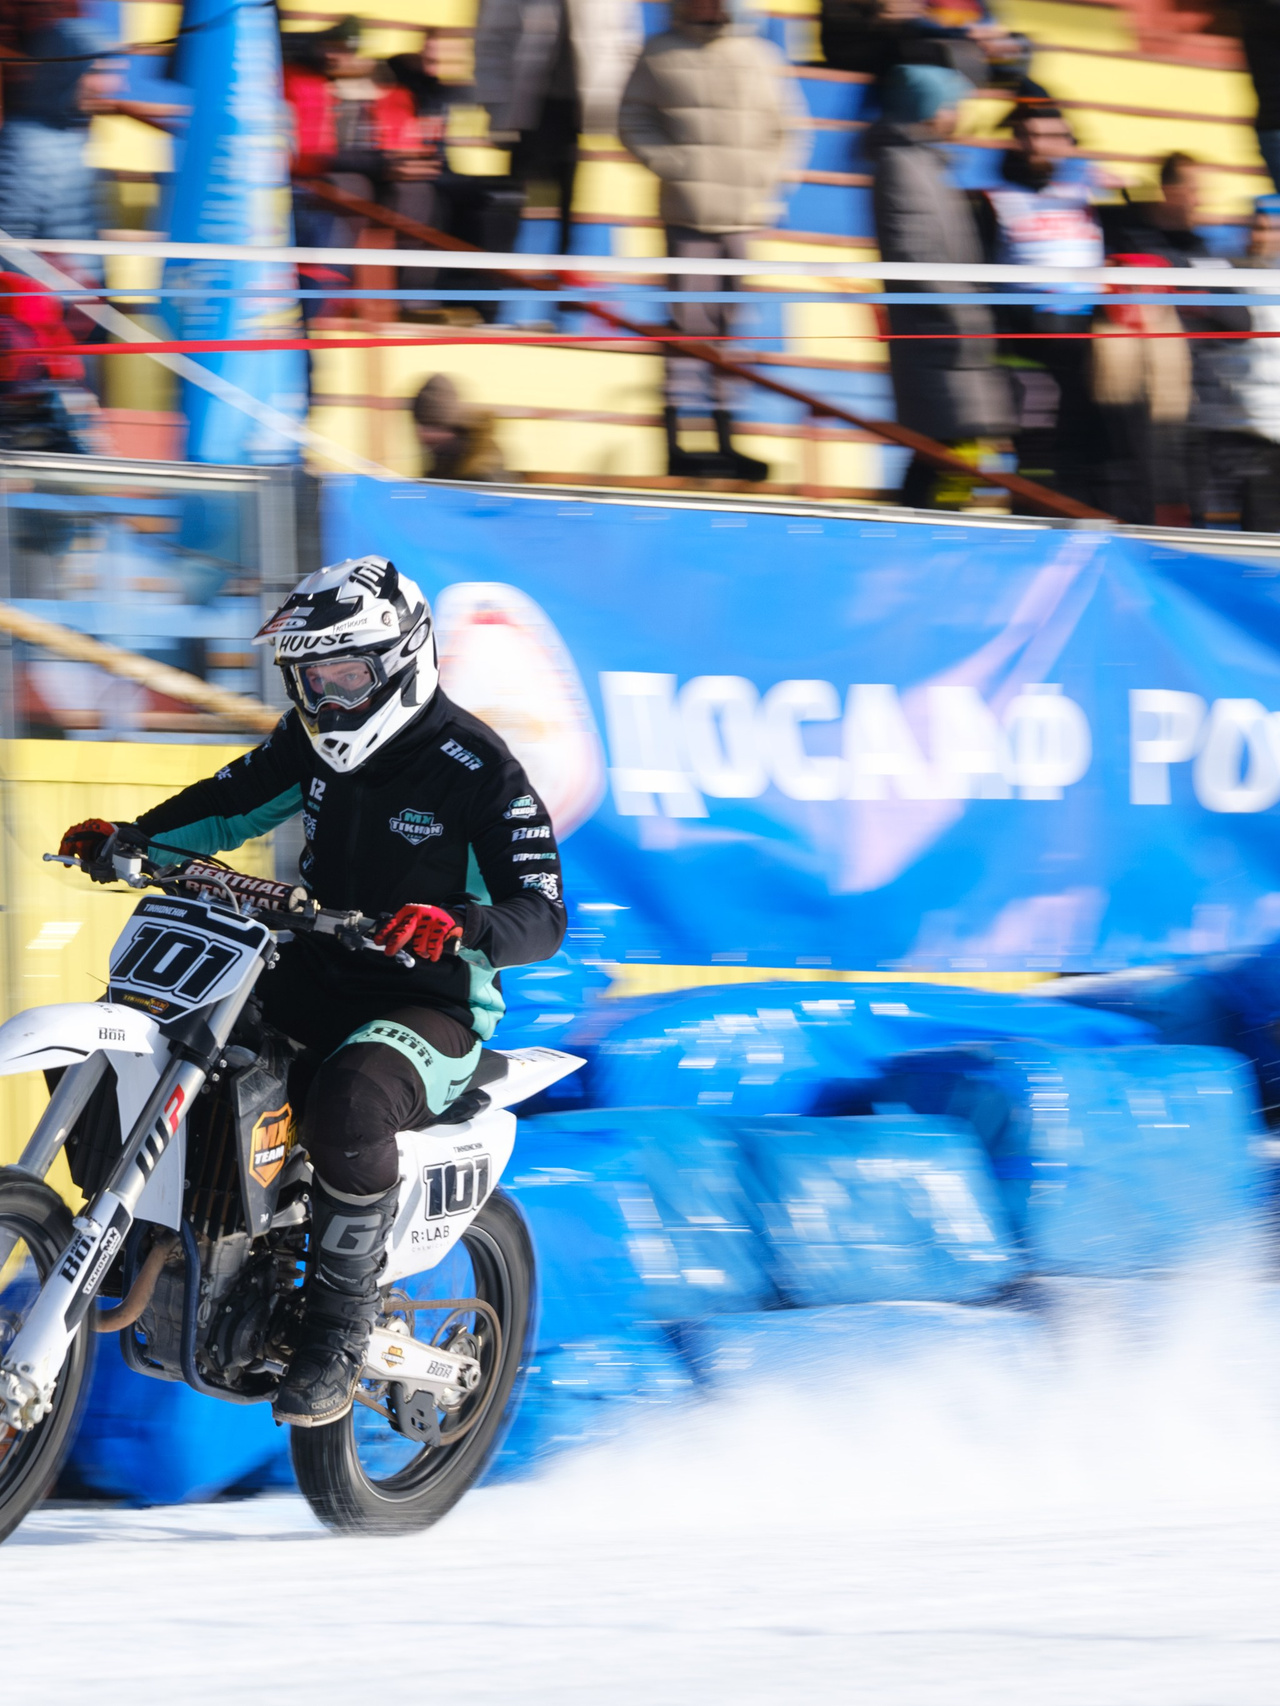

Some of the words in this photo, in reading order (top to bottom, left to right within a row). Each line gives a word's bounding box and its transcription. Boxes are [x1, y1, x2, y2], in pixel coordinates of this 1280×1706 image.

[332, 617, 368, 634] FASTHOUSE
[279, 632, 355, 652] HOUSE
[598, 670, 1093, 818] ДОСААФ
[1128, 688, 1280, 813] РО
[391, 820, 441, 836] TIKHON
[404, 812, 432, 825] MX
[184, 863, 286, 898] RENTHAL
[110, 922, 241, 1004] 101
[135, 1083, 185, 1186] WP
[254, 1115, 290, 1152] MX
[255, 1144, 285, 1165] TEAM
[423, 1153, 491, 1221] 101
[103, 1229, 118, 1252] MX
[411, 1225, 450, 1244] R:LAB
